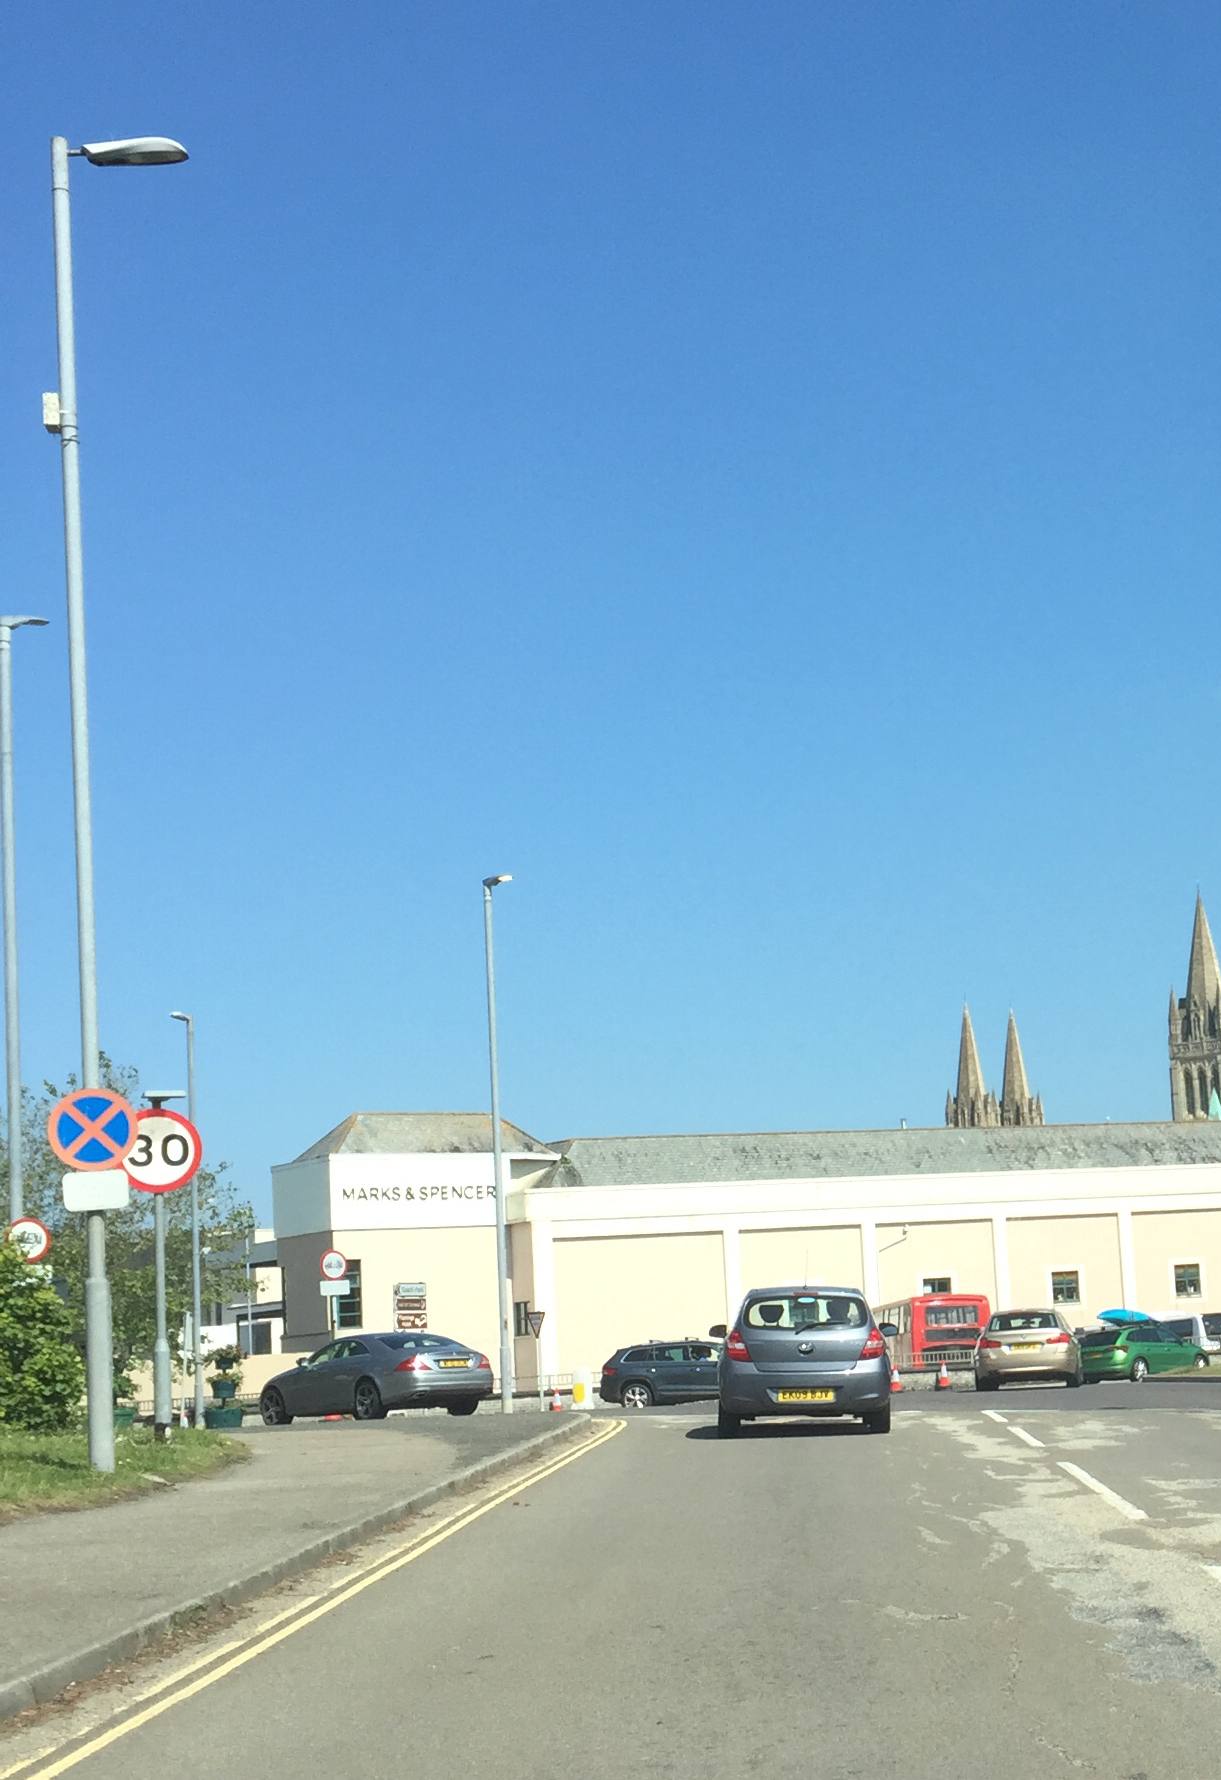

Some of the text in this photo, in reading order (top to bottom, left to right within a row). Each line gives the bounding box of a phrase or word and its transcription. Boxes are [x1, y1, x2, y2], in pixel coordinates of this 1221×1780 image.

[128, 1133, 189, 1167] 30
[342, 1186, 497, 1201] MARKS & SPENCER
